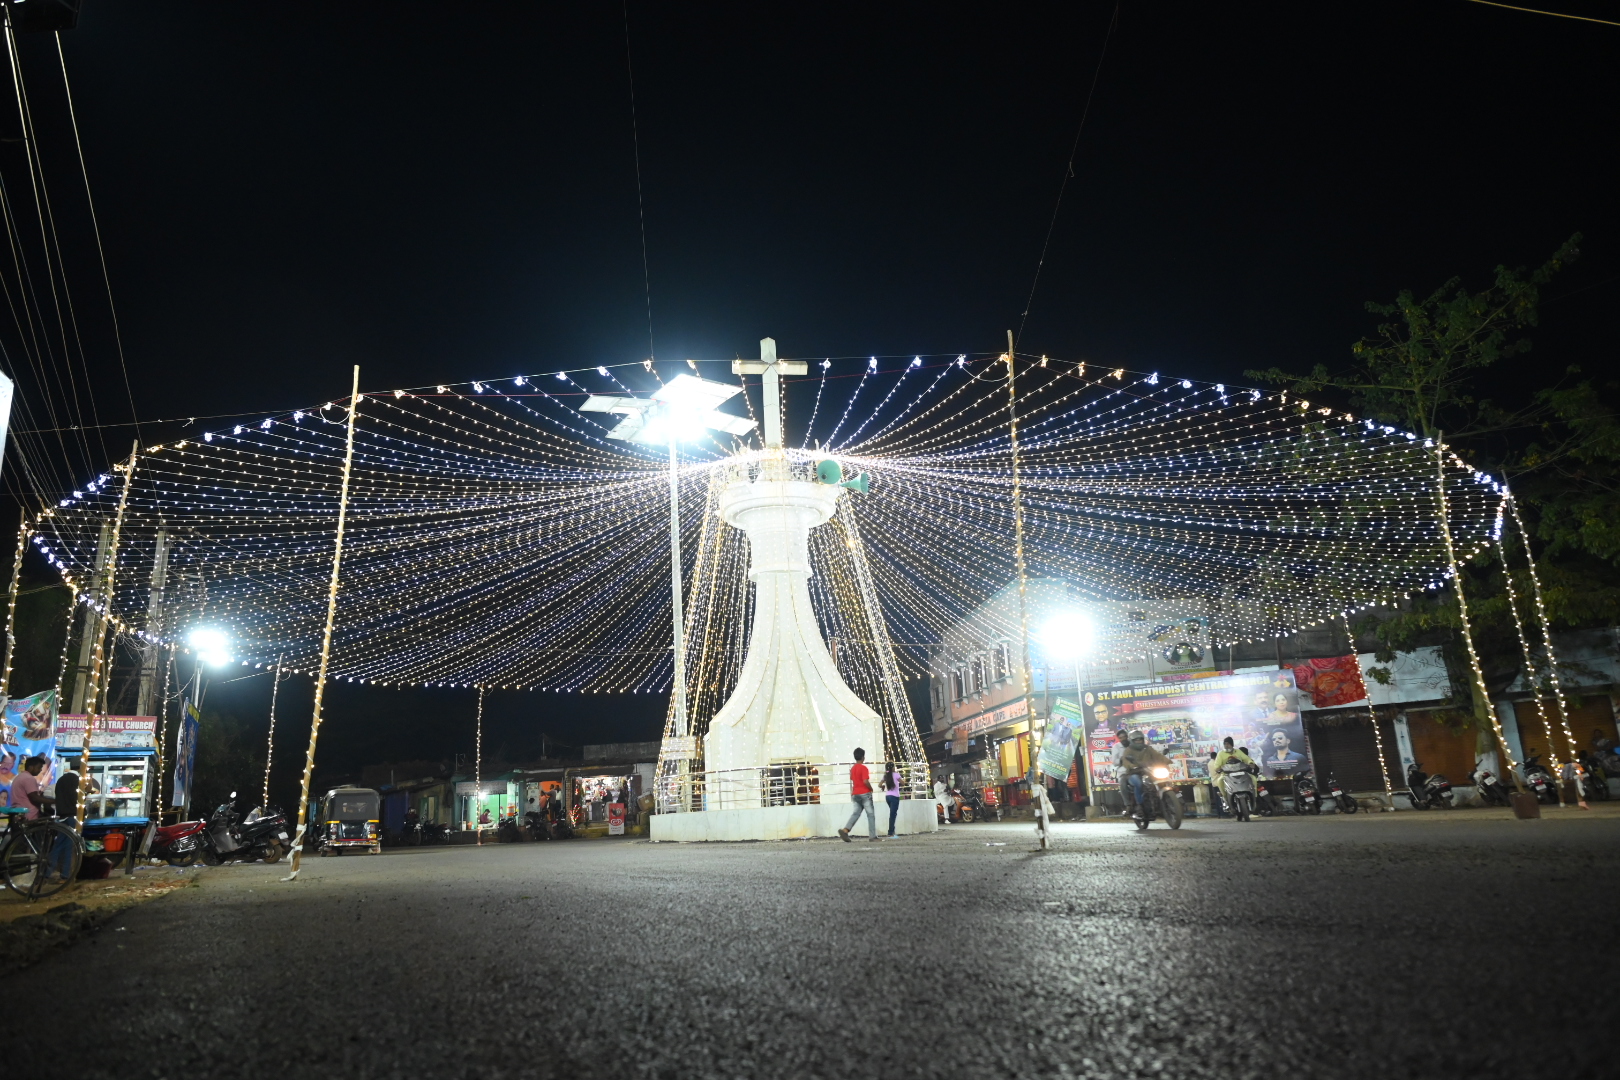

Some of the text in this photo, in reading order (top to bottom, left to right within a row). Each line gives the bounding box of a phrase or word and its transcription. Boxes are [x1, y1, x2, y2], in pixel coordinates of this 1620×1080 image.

[1097, 691, 1110, 701] ST.
[1111, 689, 1133, 699] PAUL
[1134, 684, 1186, 698] METHODIST
[1187, 680, 1229, 692] CENTRAL
[1229, 676, 1270, 687] CHURCH
[1135, 700, 1170, 709] CHRISTMAS
[1170, 697, 1190, 705] SPORTS
[126, 721, 154, 730] CHURCH
